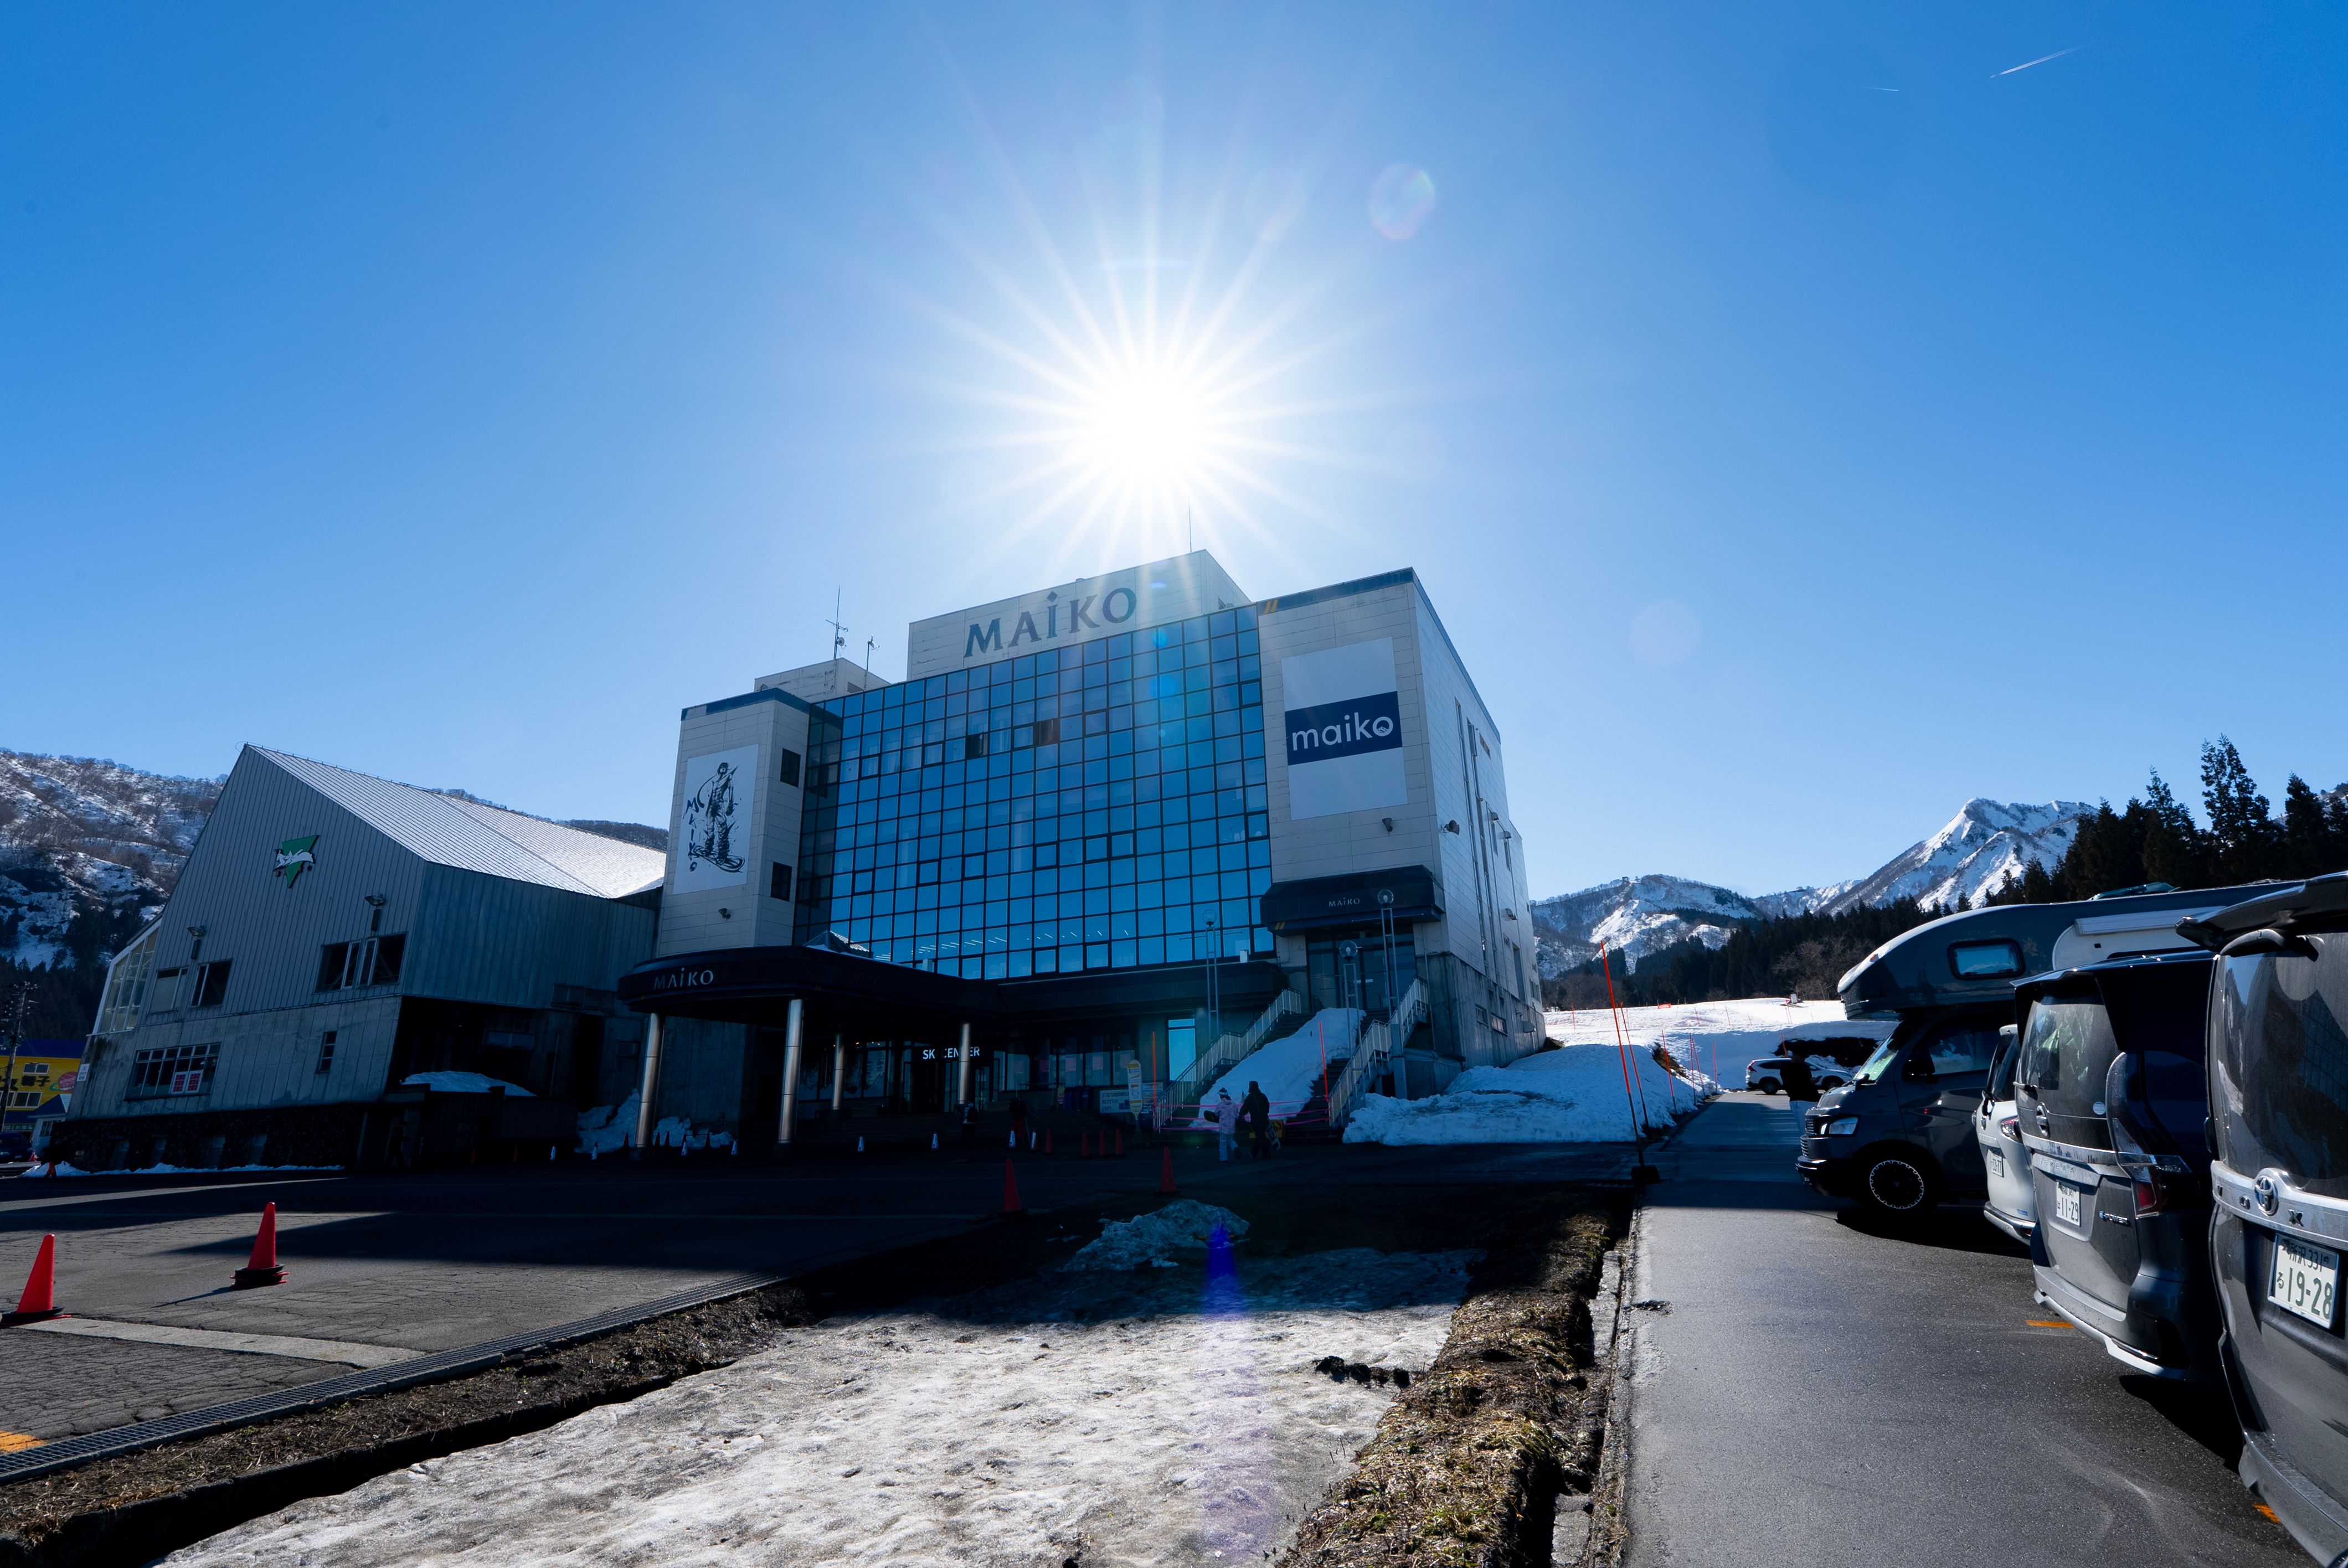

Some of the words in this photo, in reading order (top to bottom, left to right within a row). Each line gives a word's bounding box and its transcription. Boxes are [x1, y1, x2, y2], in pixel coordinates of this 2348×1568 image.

[1292, 712, 1394, 751] maiko
[2062, 1197, 2078, 1222] 11-29
[2277, 1272, 2284, 1289] る
[2288, 1267, 2333, 1319] 19-28
